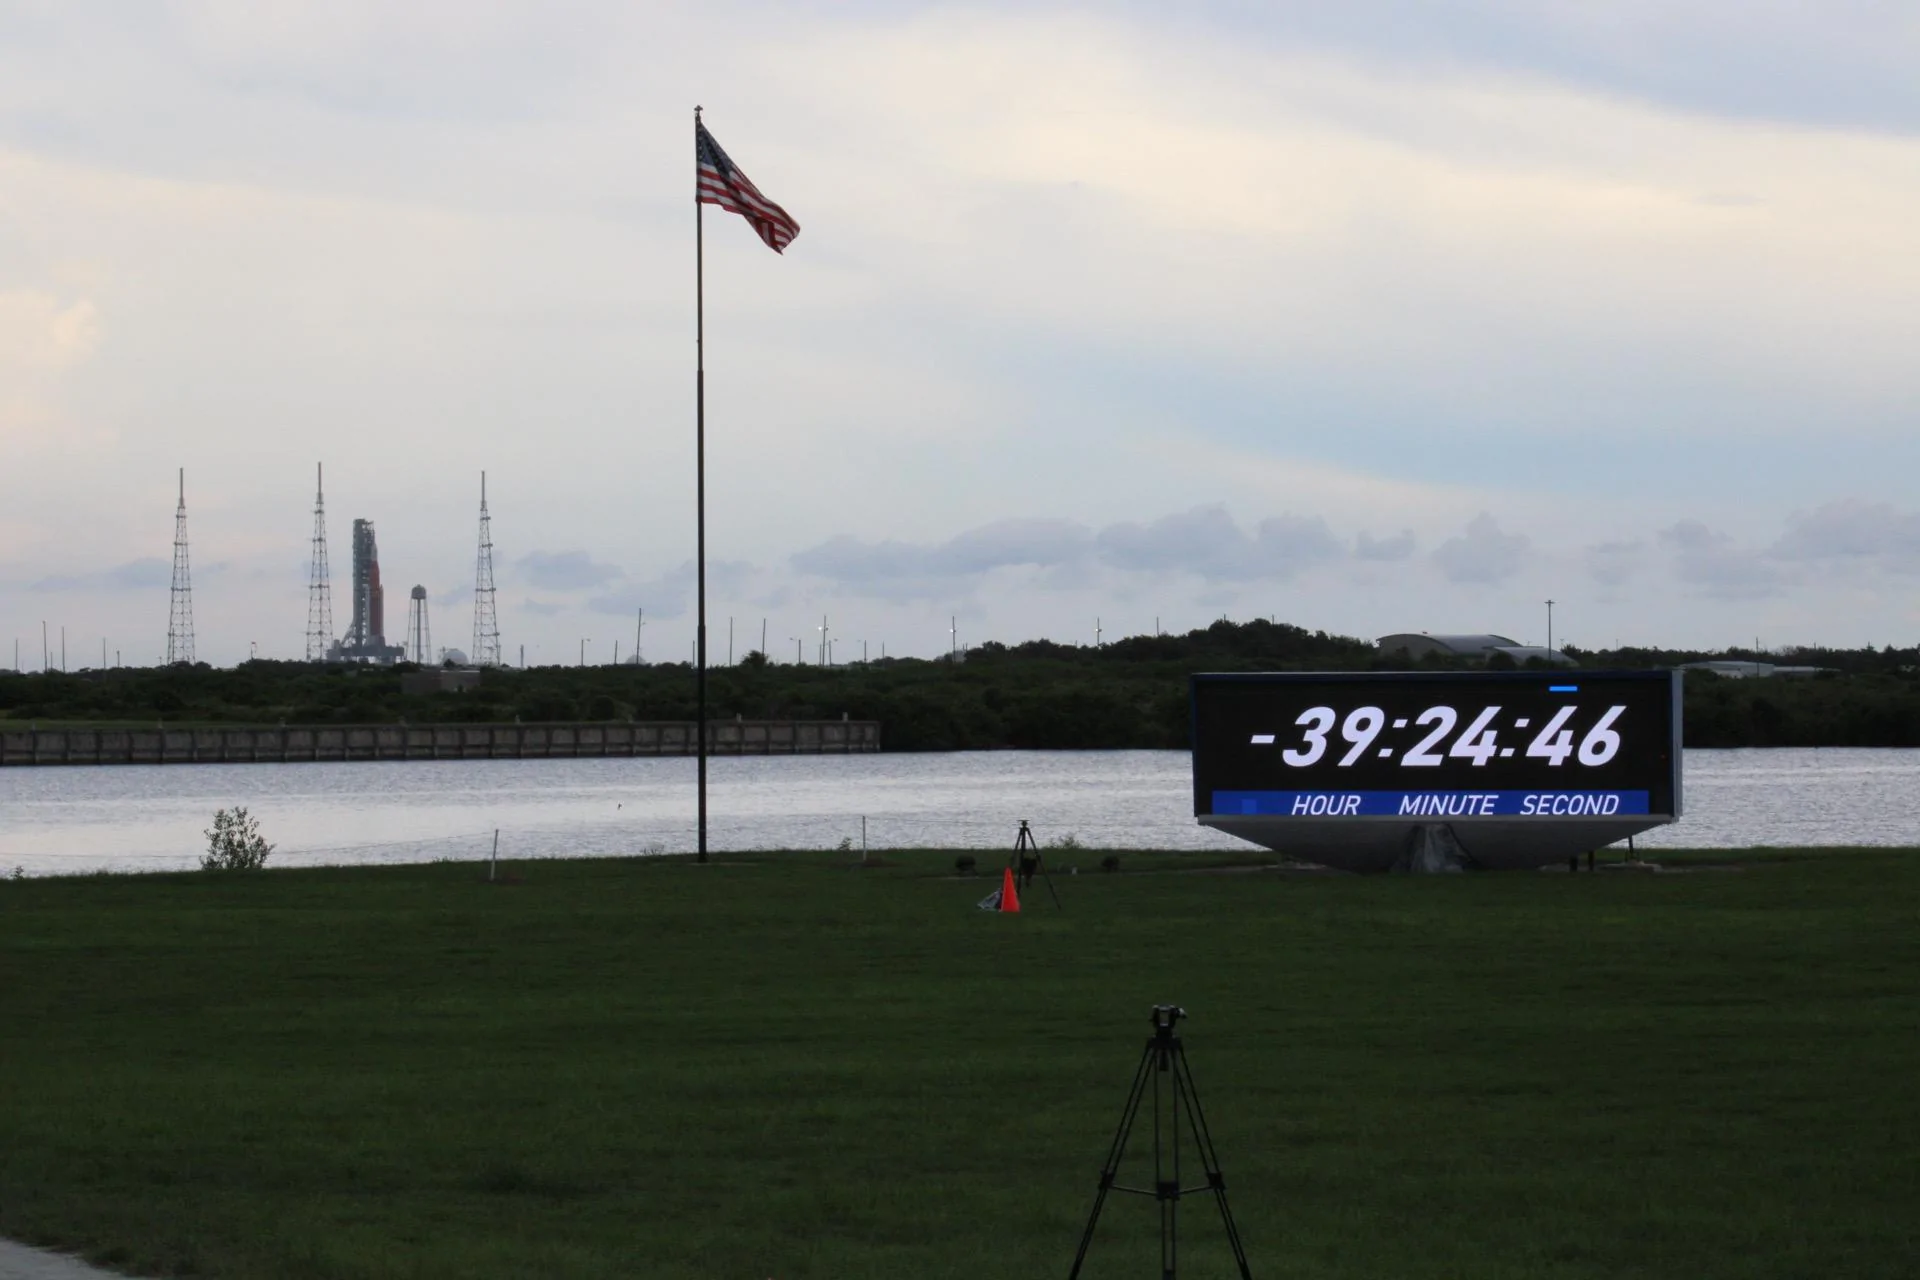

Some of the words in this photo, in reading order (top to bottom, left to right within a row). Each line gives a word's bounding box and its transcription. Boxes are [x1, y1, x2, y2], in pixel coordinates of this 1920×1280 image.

[1251, 706, 1626, 766] -39:24:46
[1292, 795, 1361, 815] HOUR
[1399, 795, 1498, 815] MINUTE
[1520, 795, 1619, 815] SECOND
